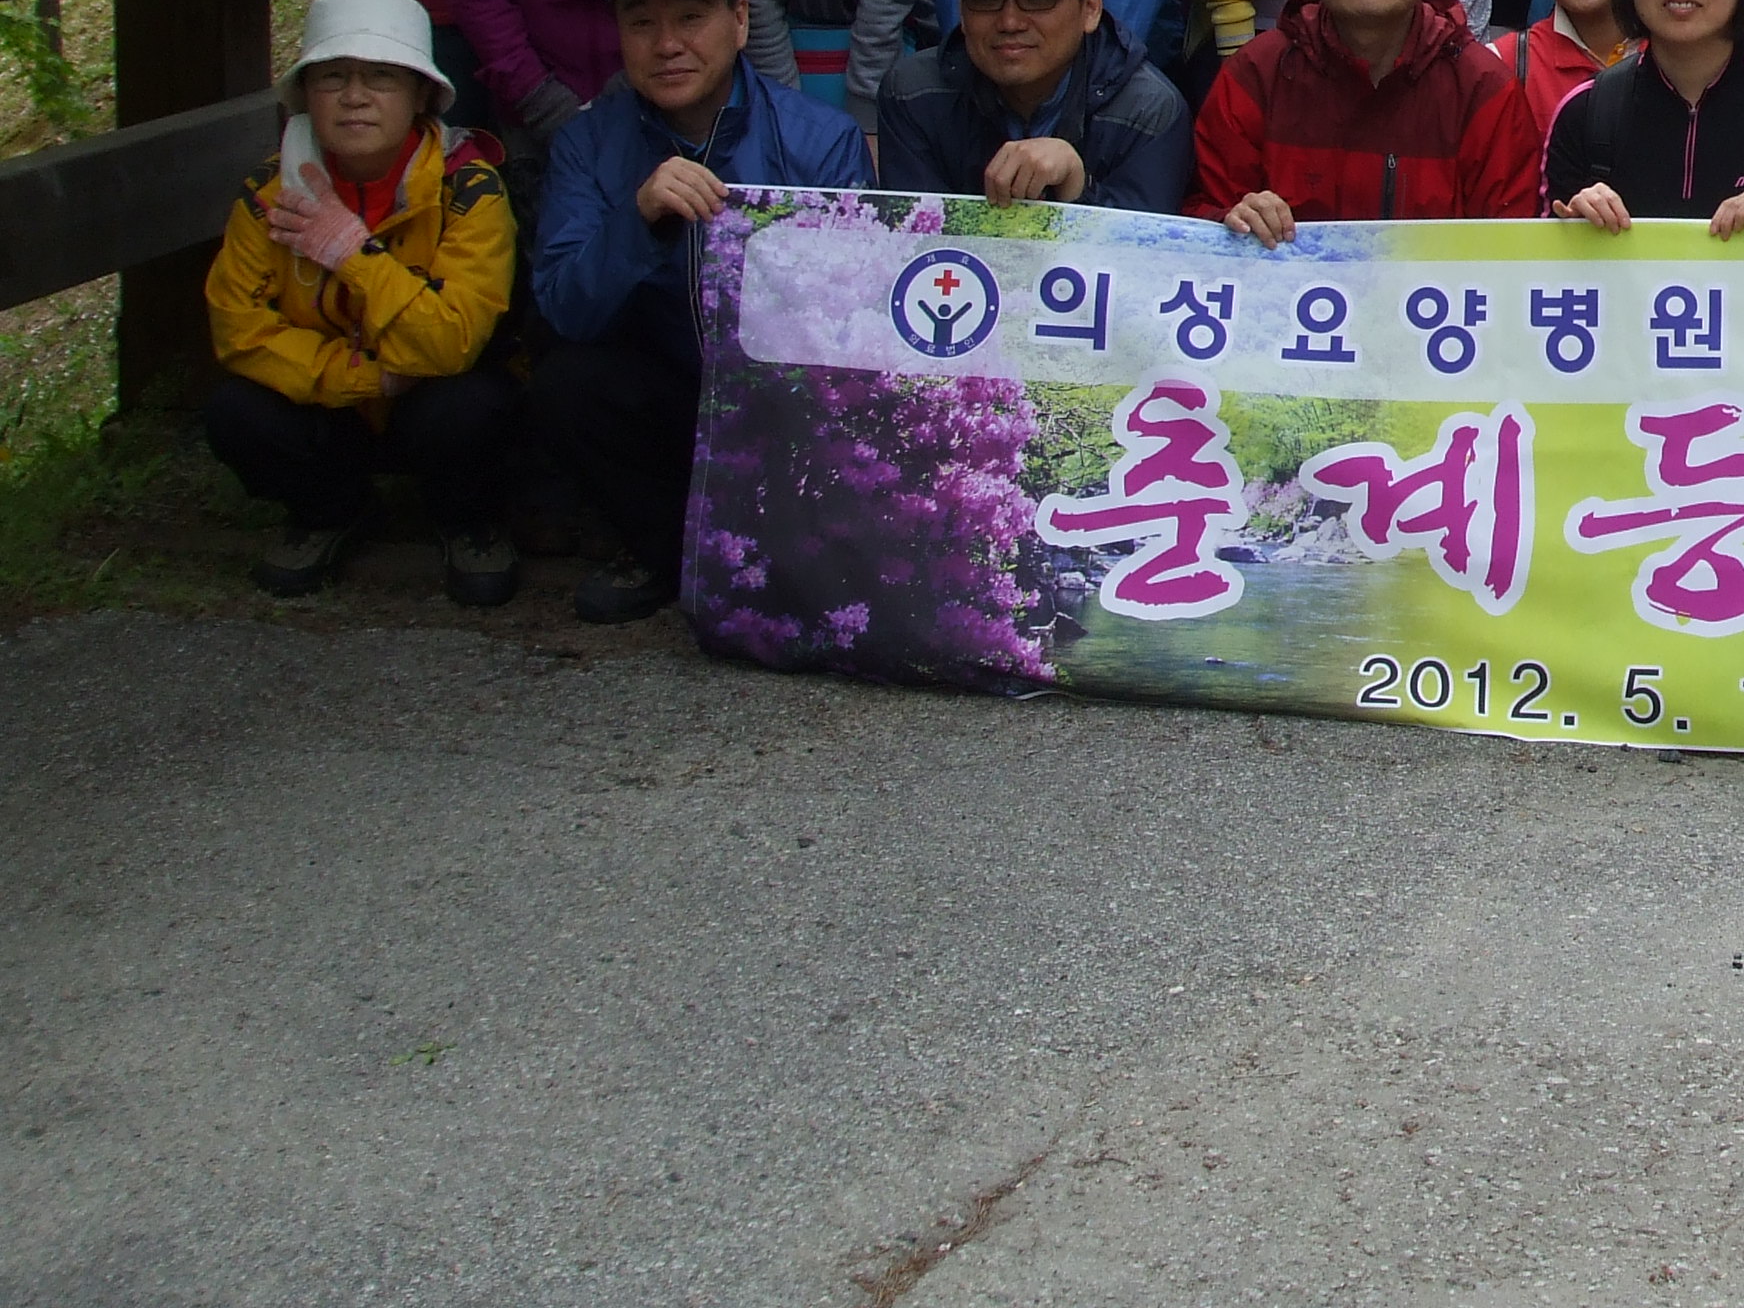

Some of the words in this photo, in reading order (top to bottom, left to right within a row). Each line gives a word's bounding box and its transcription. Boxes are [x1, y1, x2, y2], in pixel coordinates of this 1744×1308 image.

[1035, 265, 1724, 374] 의성요양병원
[1359, 657, 1577, 728] 2012.
[1624, 668, 1691, 731] 5.
